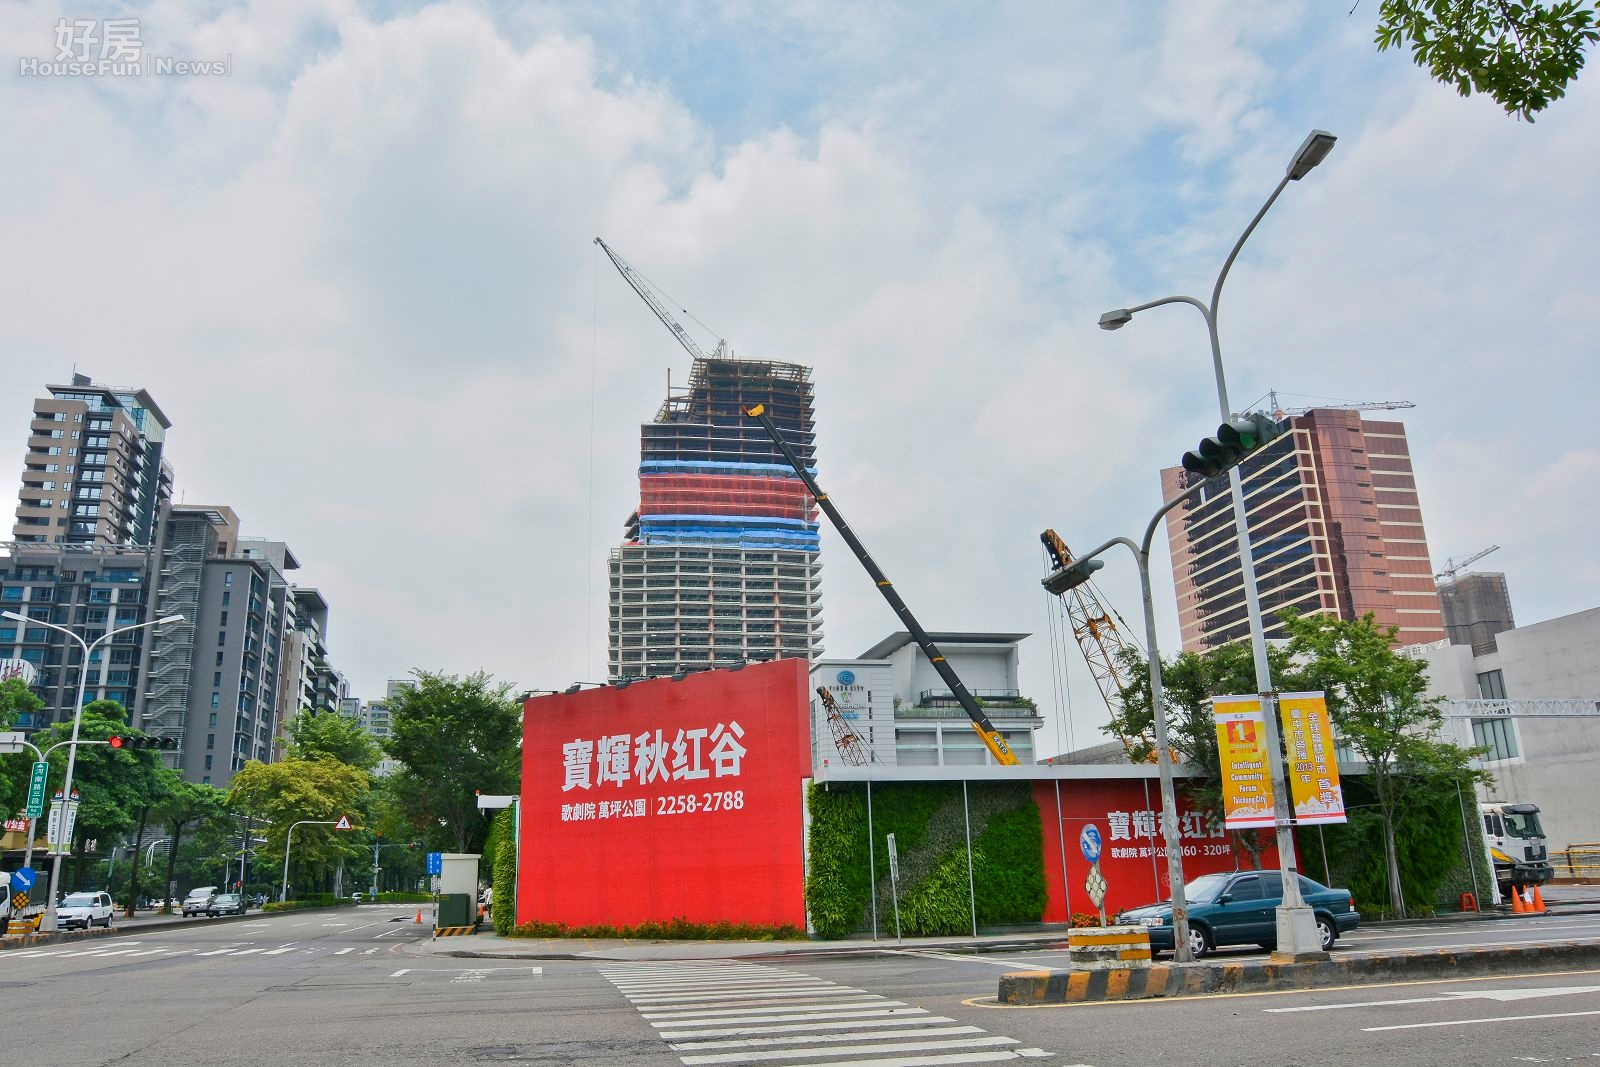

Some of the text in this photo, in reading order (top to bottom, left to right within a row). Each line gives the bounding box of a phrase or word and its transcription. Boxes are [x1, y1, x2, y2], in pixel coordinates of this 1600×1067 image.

[993, 735, 1007, 754] KATO
[561, 720, 747, 792] 寶輝秋红谷
[1231, 760, 1263, 771] Intelligent
[1295, 762, 1314, 772] 2013
[1230, 772, 1263, 781] Community
[1301, 774, 1312, 784] 年
[31, 768, 44, 805] 河南路三段
[1239, 784, 1257, 793] Forum
[561, 790, 744, 822] 歌劇院 萬坪公園 2258-2788
[1111, 847, 1137, 859] 歌劇院
[1139, 845, 1173, 858] 萬坪公
